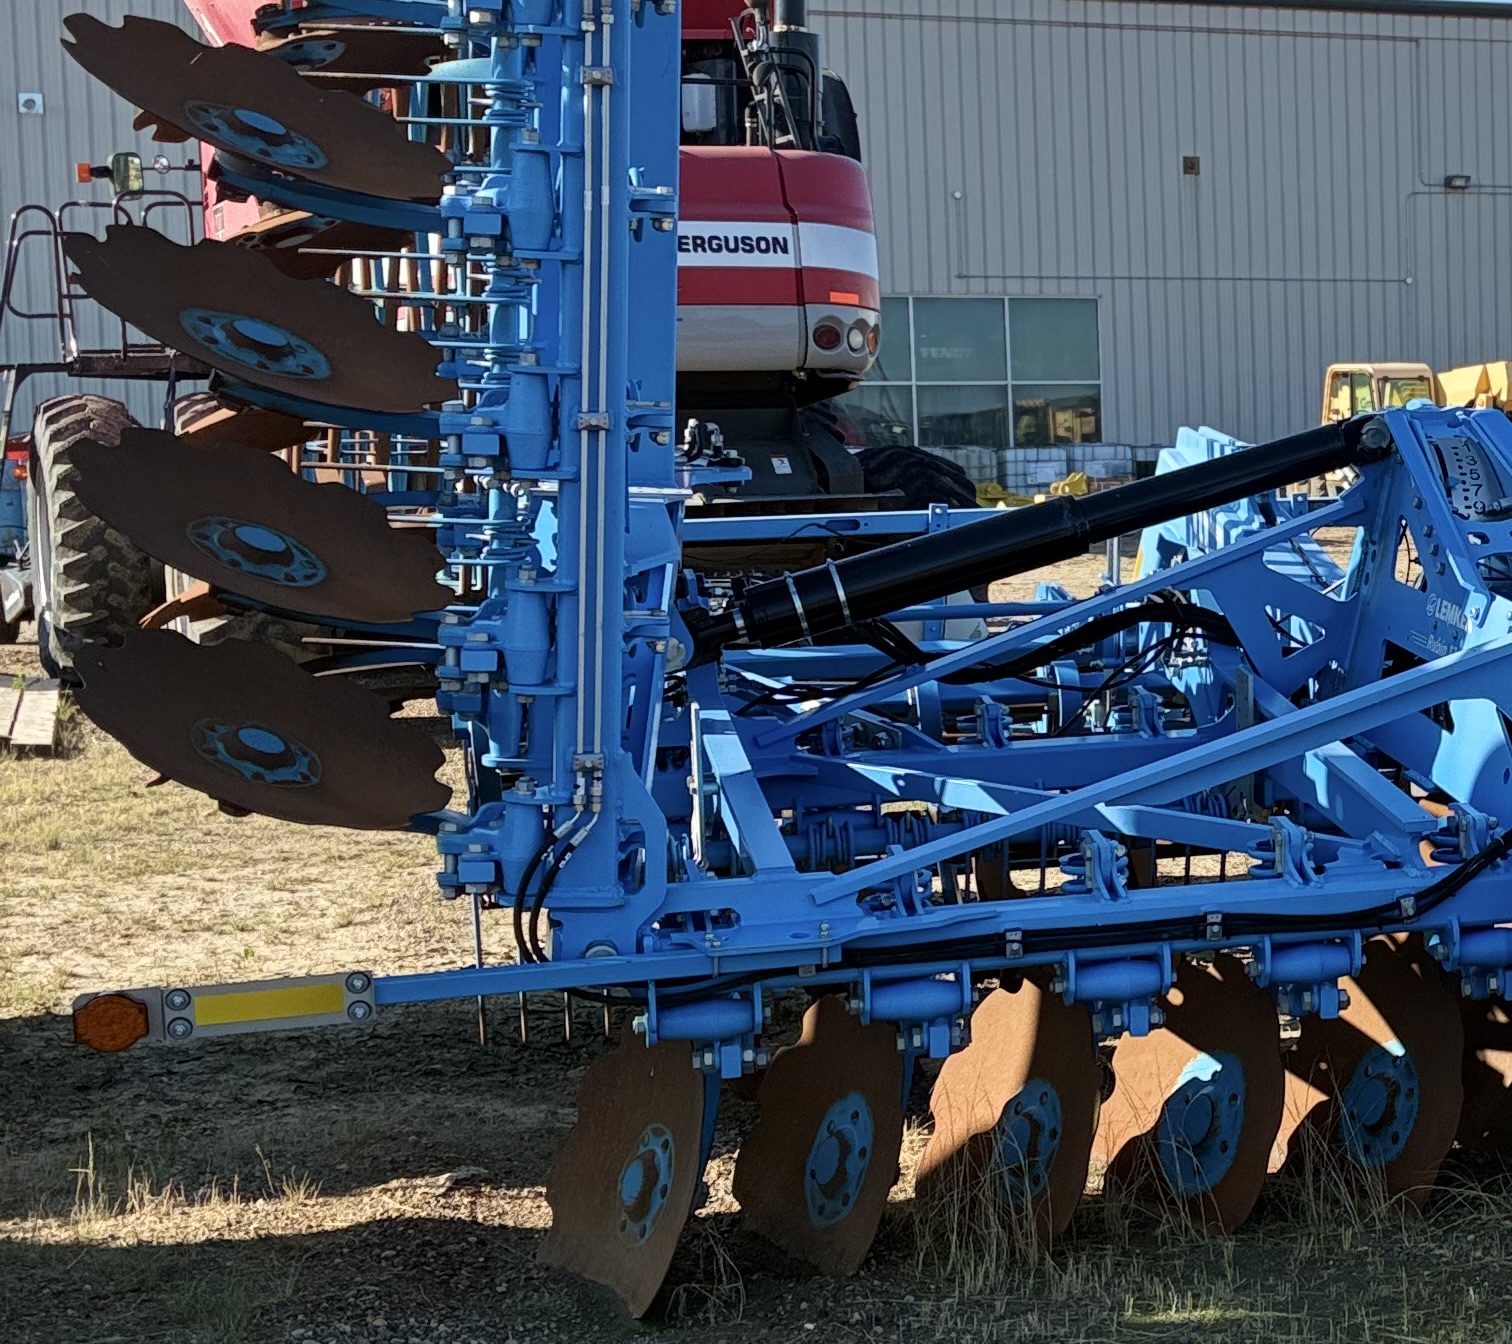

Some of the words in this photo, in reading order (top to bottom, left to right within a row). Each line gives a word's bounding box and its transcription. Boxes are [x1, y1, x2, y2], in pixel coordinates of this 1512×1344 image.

[677, 235, 789, 255] ERGUSON
[1465, 455, 1478, 467] 3
[1469, 468, 1481, 481] 5
[1469, 483, 1484, 497] 7
[1472, 500, 1486, 515] 9
